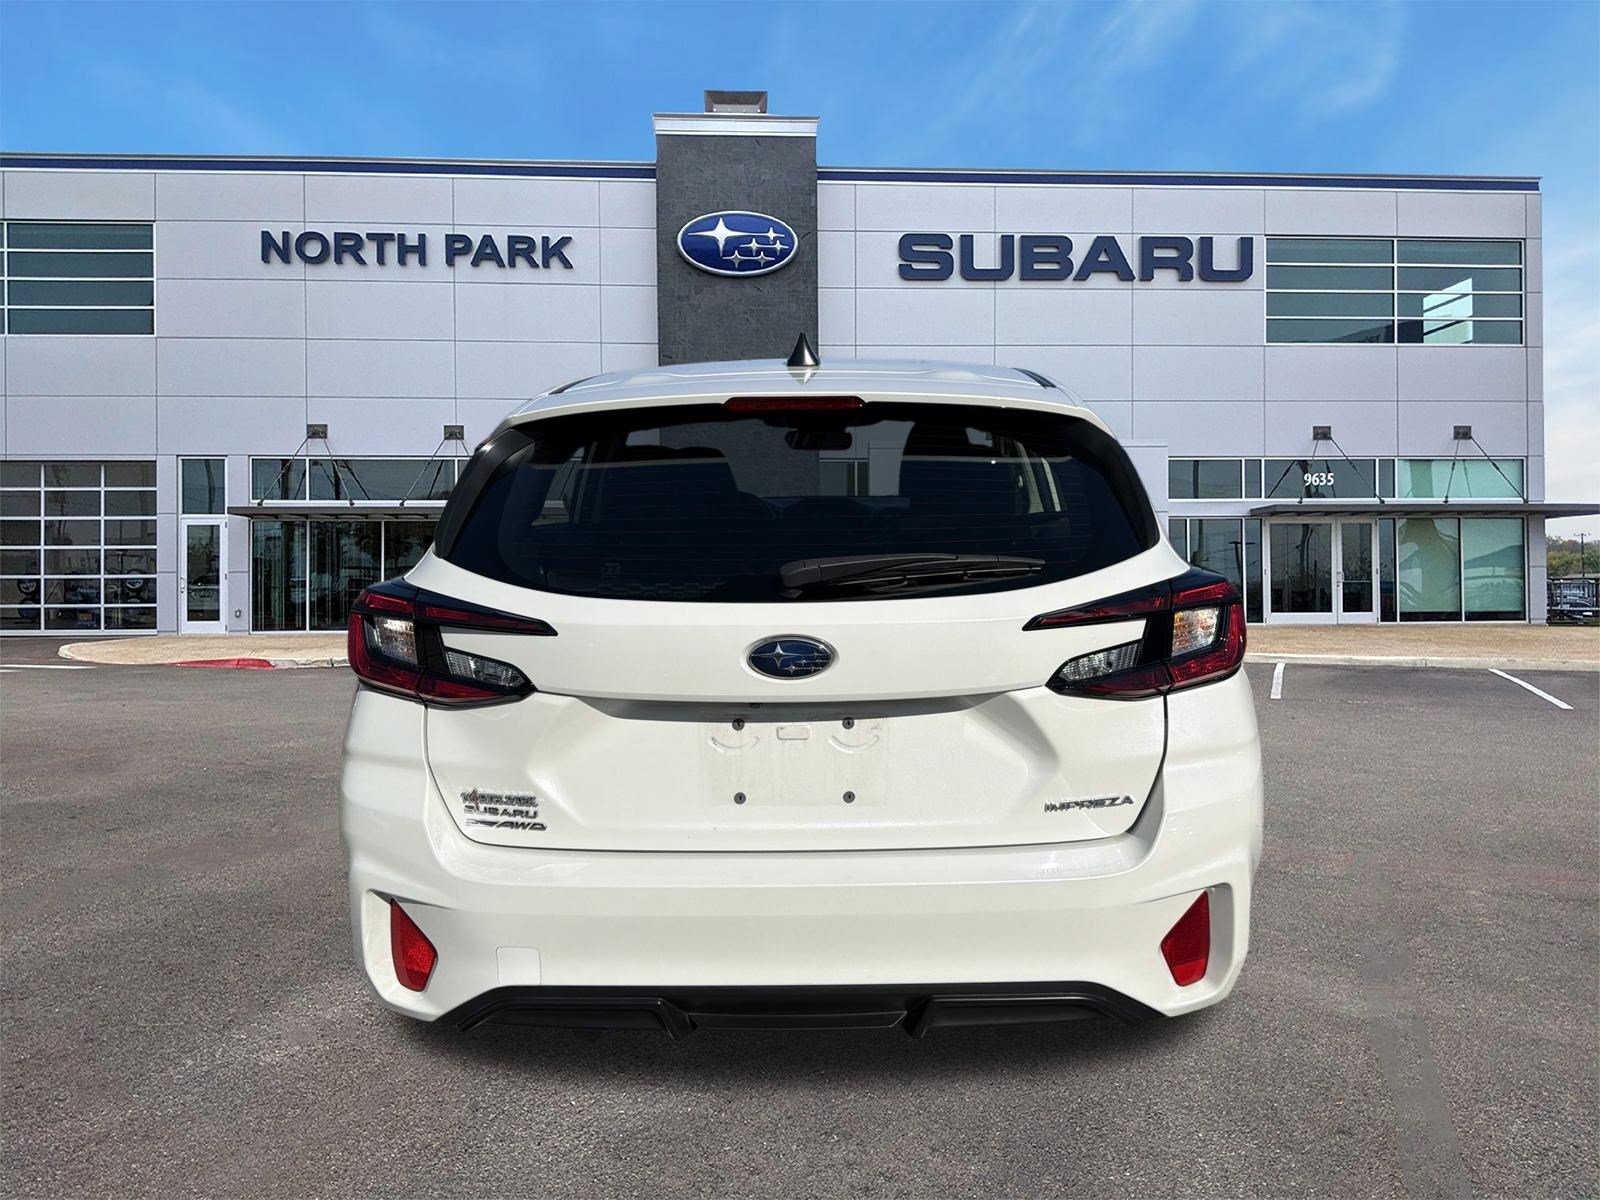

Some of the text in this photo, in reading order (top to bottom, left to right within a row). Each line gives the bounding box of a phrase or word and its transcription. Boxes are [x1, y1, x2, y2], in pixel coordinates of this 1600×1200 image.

[260, 230, 574, 269] NORTH PARK
[898, 233, 1254, 282] SUBARU
[1303, 472, 1335, 486] 9635
[464, 804, 538, 819] SUBARU
[1044, 795, 1134, 813] IMPREZA
[496, 820, 547, 831] AWD
